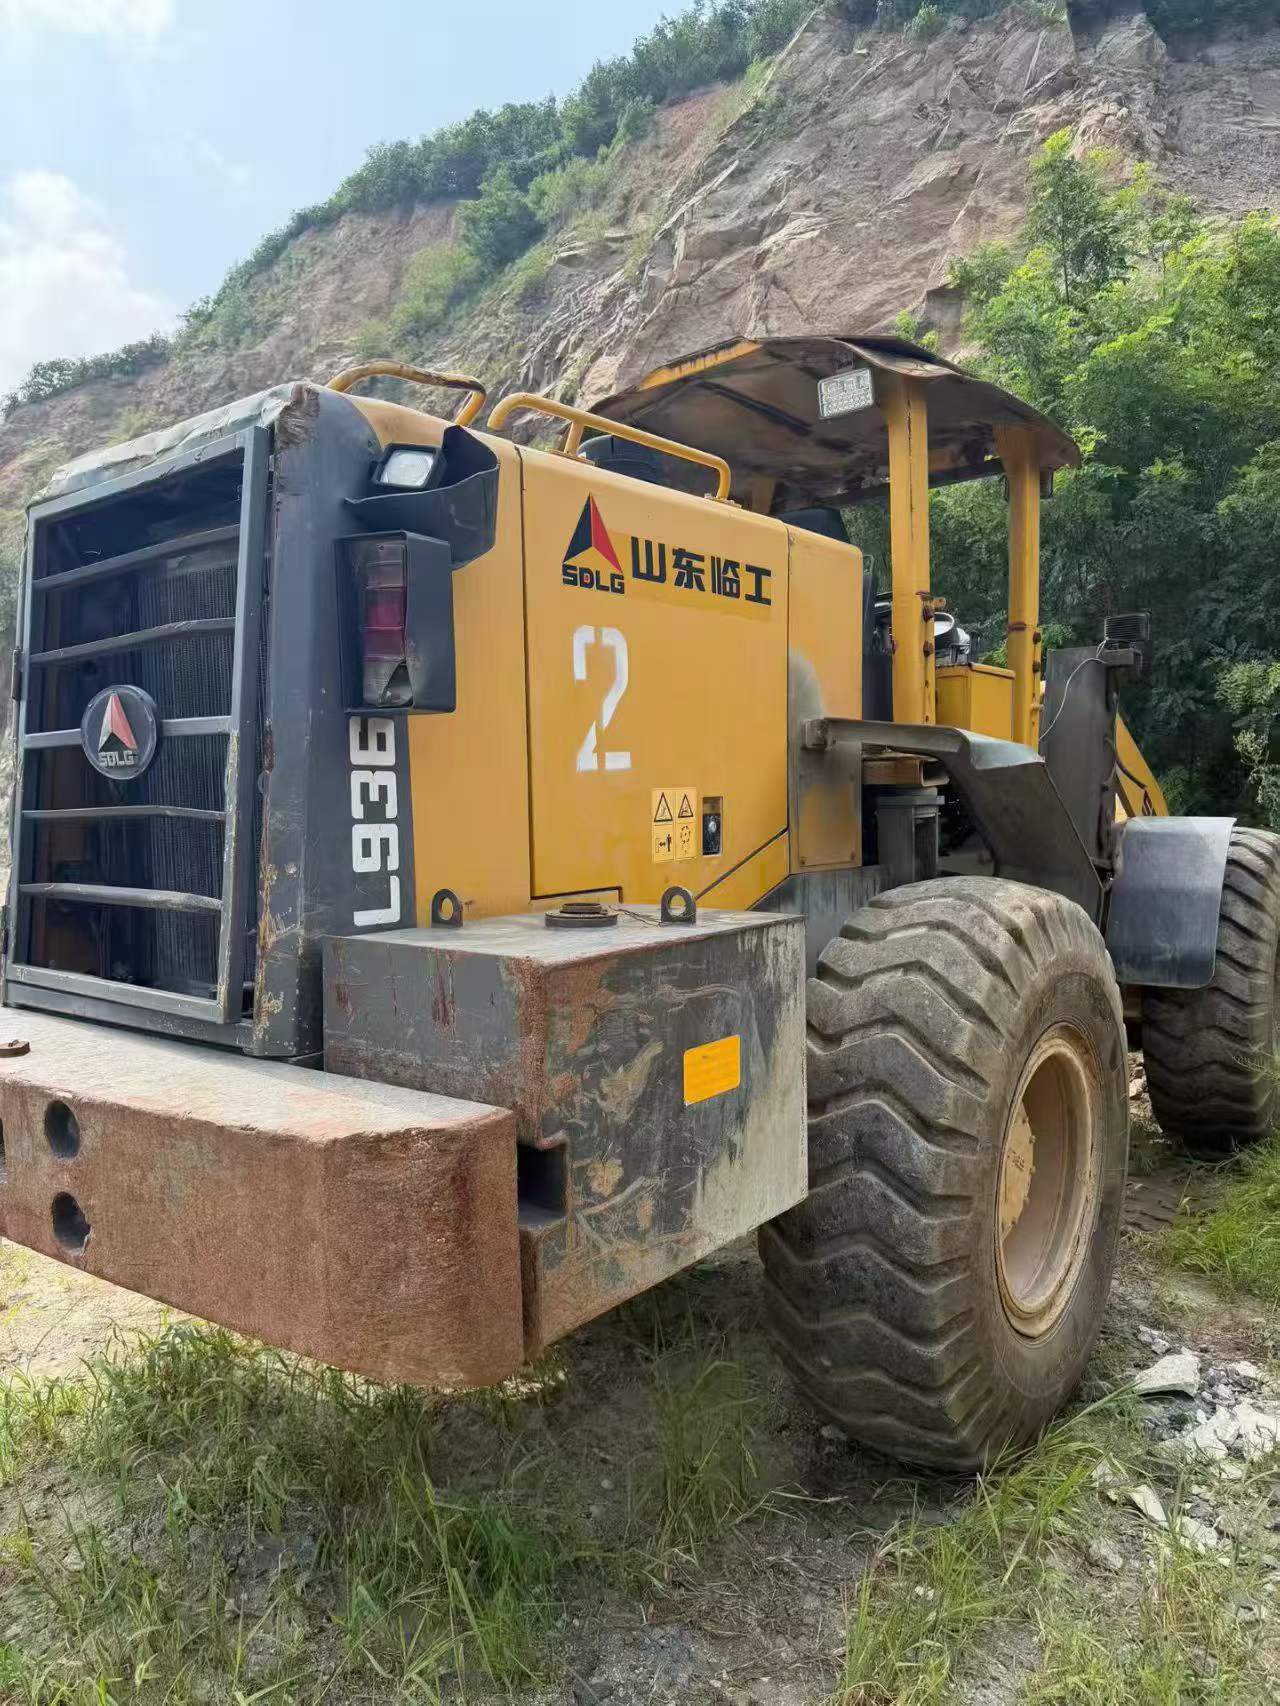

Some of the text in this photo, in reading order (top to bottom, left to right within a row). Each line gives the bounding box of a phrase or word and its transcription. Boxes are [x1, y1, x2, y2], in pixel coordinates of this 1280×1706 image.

[562, 563, 625, 594] SDLG
[631, 536, 772, 606] 山东临工
[573, 625, 632, 772] 2
[98, 750, 138, 767] SDLG
[349, 716, 401, 927] L936
